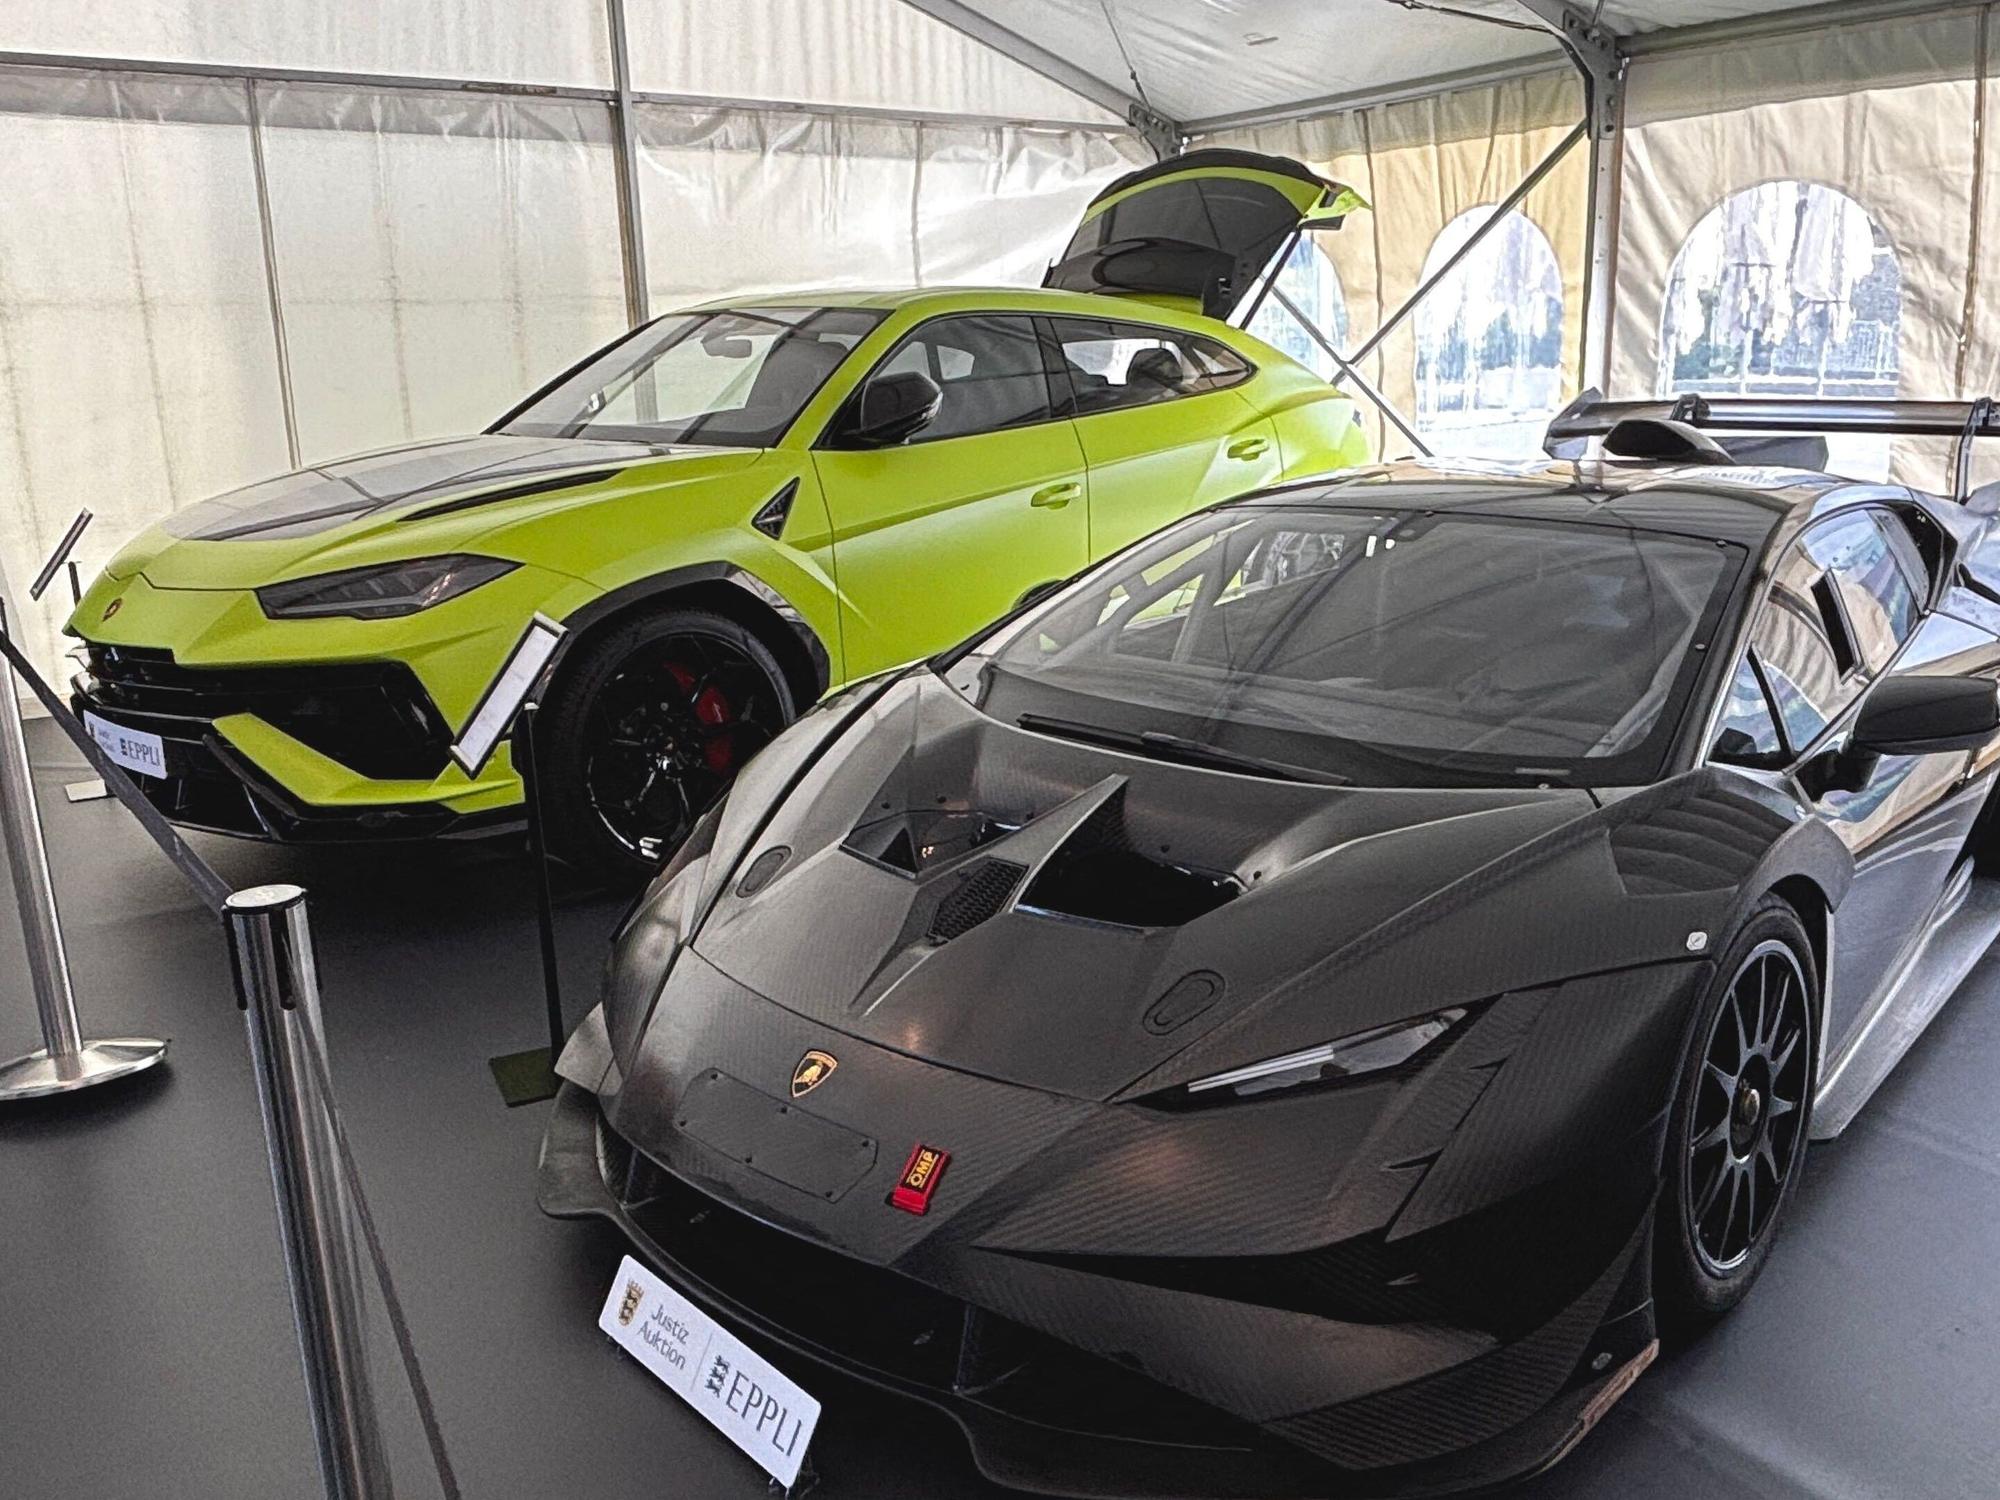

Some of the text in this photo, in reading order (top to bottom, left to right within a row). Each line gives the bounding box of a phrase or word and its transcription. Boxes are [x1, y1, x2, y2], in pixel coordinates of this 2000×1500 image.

[127, 740, 160, 767] EPPLI
[909, 1150, 936, 1187] OMP
[650, 1304, 690, 1345] Justiz
[636, 1320, 687, 1371] Auktion
[725, 1369, 803, 1457] EPPLI
